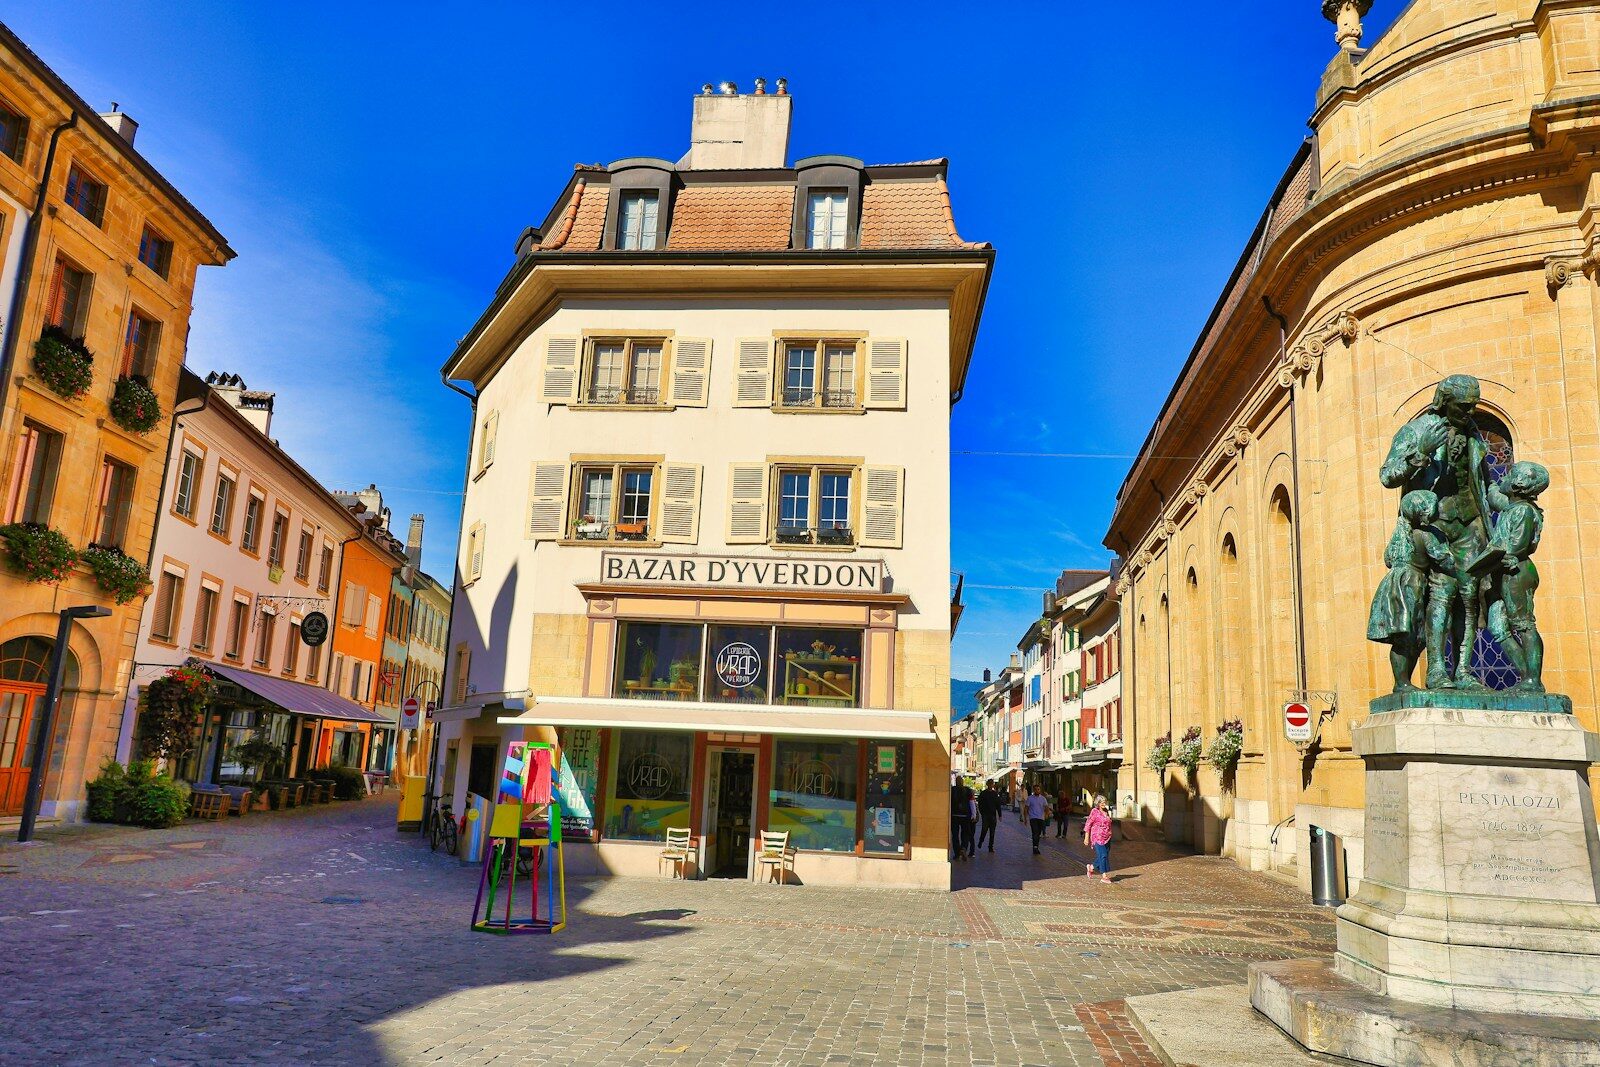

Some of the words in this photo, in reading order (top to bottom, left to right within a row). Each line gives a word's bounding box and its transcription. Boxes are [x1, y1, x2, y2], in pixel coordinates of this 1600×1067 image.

[606, 558, 697, 582] BAZAR
[707, 559, 876, 588] D'YVERDON
[720, 654, 757, 676] VRAC
[725, 675, 750, 683] YVERDON
[573, 730, 591, 748] ESP
[631, 764, 668, 788] VRAC
[795, 771, 833, 795] VRAC
[1460, 792, 1560, 809] PESTALOZZI
